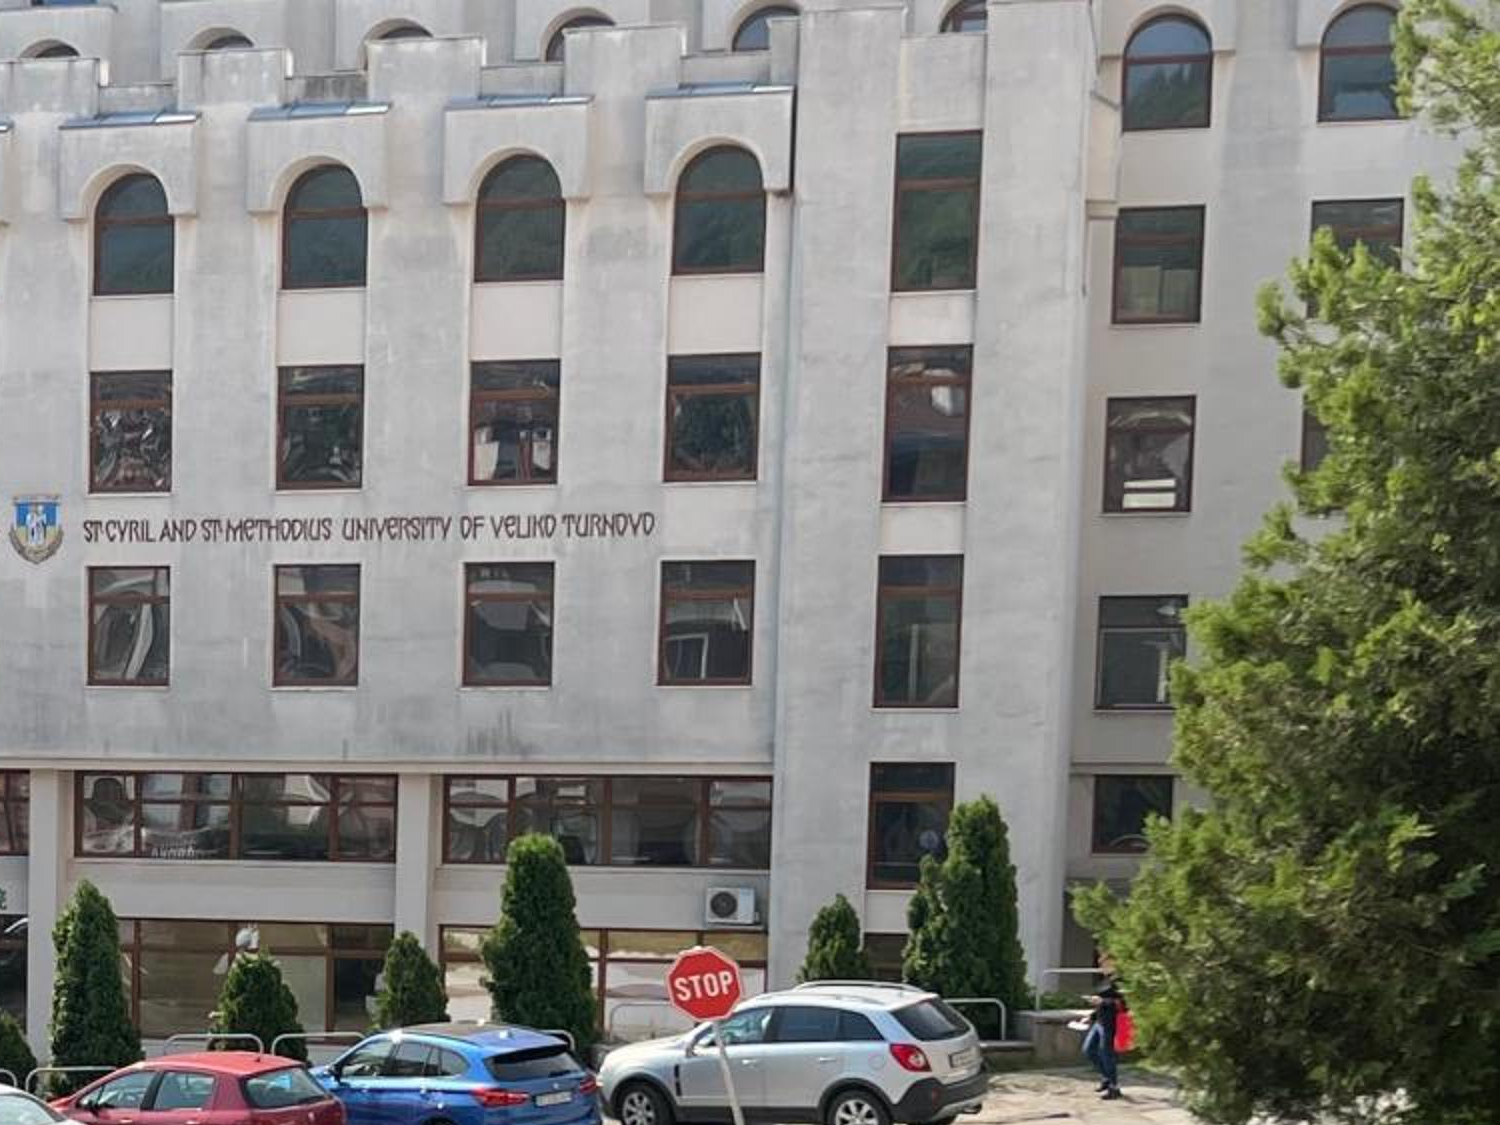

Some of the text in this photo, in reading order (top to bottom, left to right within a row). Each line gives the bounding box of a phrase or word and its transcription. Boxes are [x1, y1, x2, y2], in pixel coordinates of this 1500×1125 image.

[159, 519, 197, 542] AND
[342, 516, 452, 541] UNIVERSITY
[460, 515, 485, 540] OF
[490, 513, 557, 538] VELIKO
[561, 512, 655, 537] TURNOVO
[674, 971, 734, 1001] STOP
